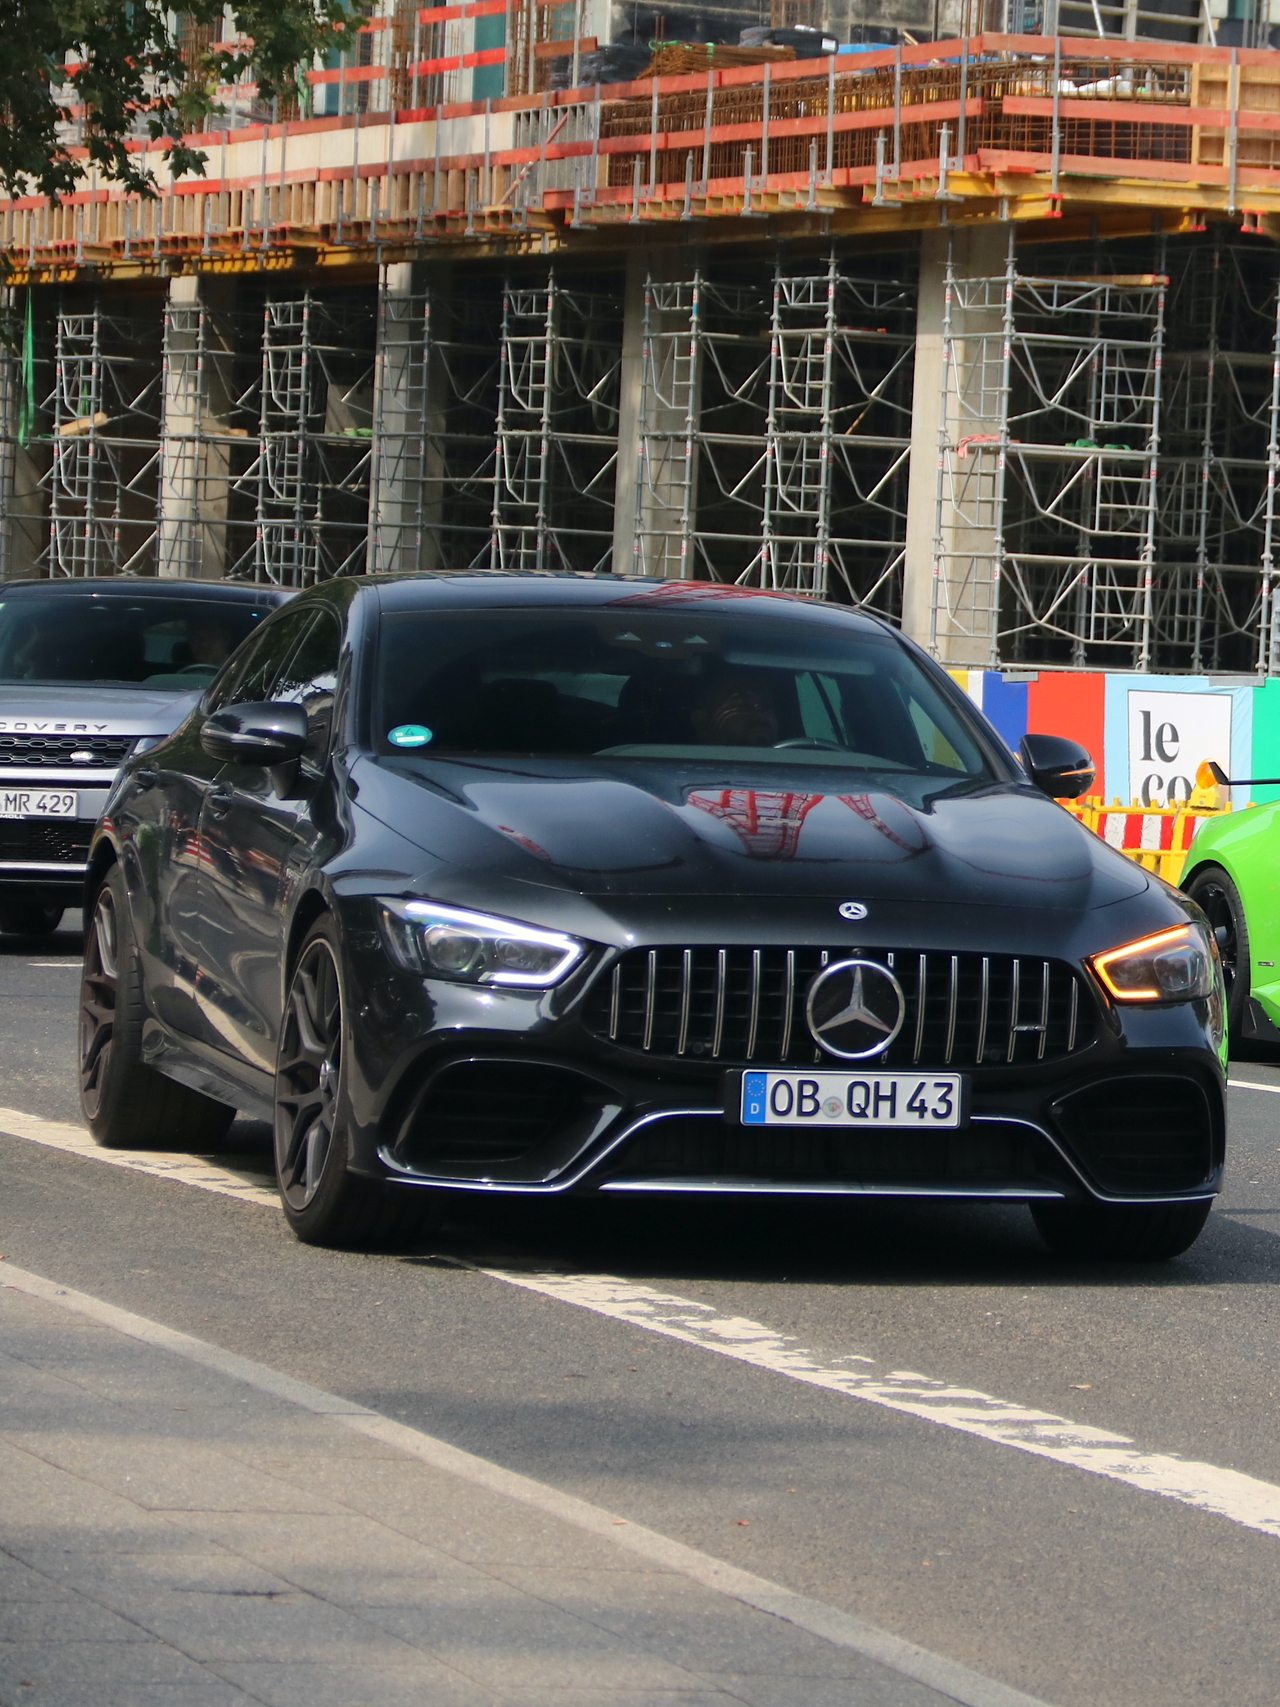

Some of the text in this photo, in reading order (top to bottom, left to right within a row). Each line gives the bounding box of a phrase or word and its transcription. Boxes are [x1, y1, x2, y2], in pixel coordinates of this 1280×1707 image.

[1138, 710, 1180, 763] le
[4, 793, 74, 813] MR 429
[750, 1079, 953, 1119] D OB QH 43
